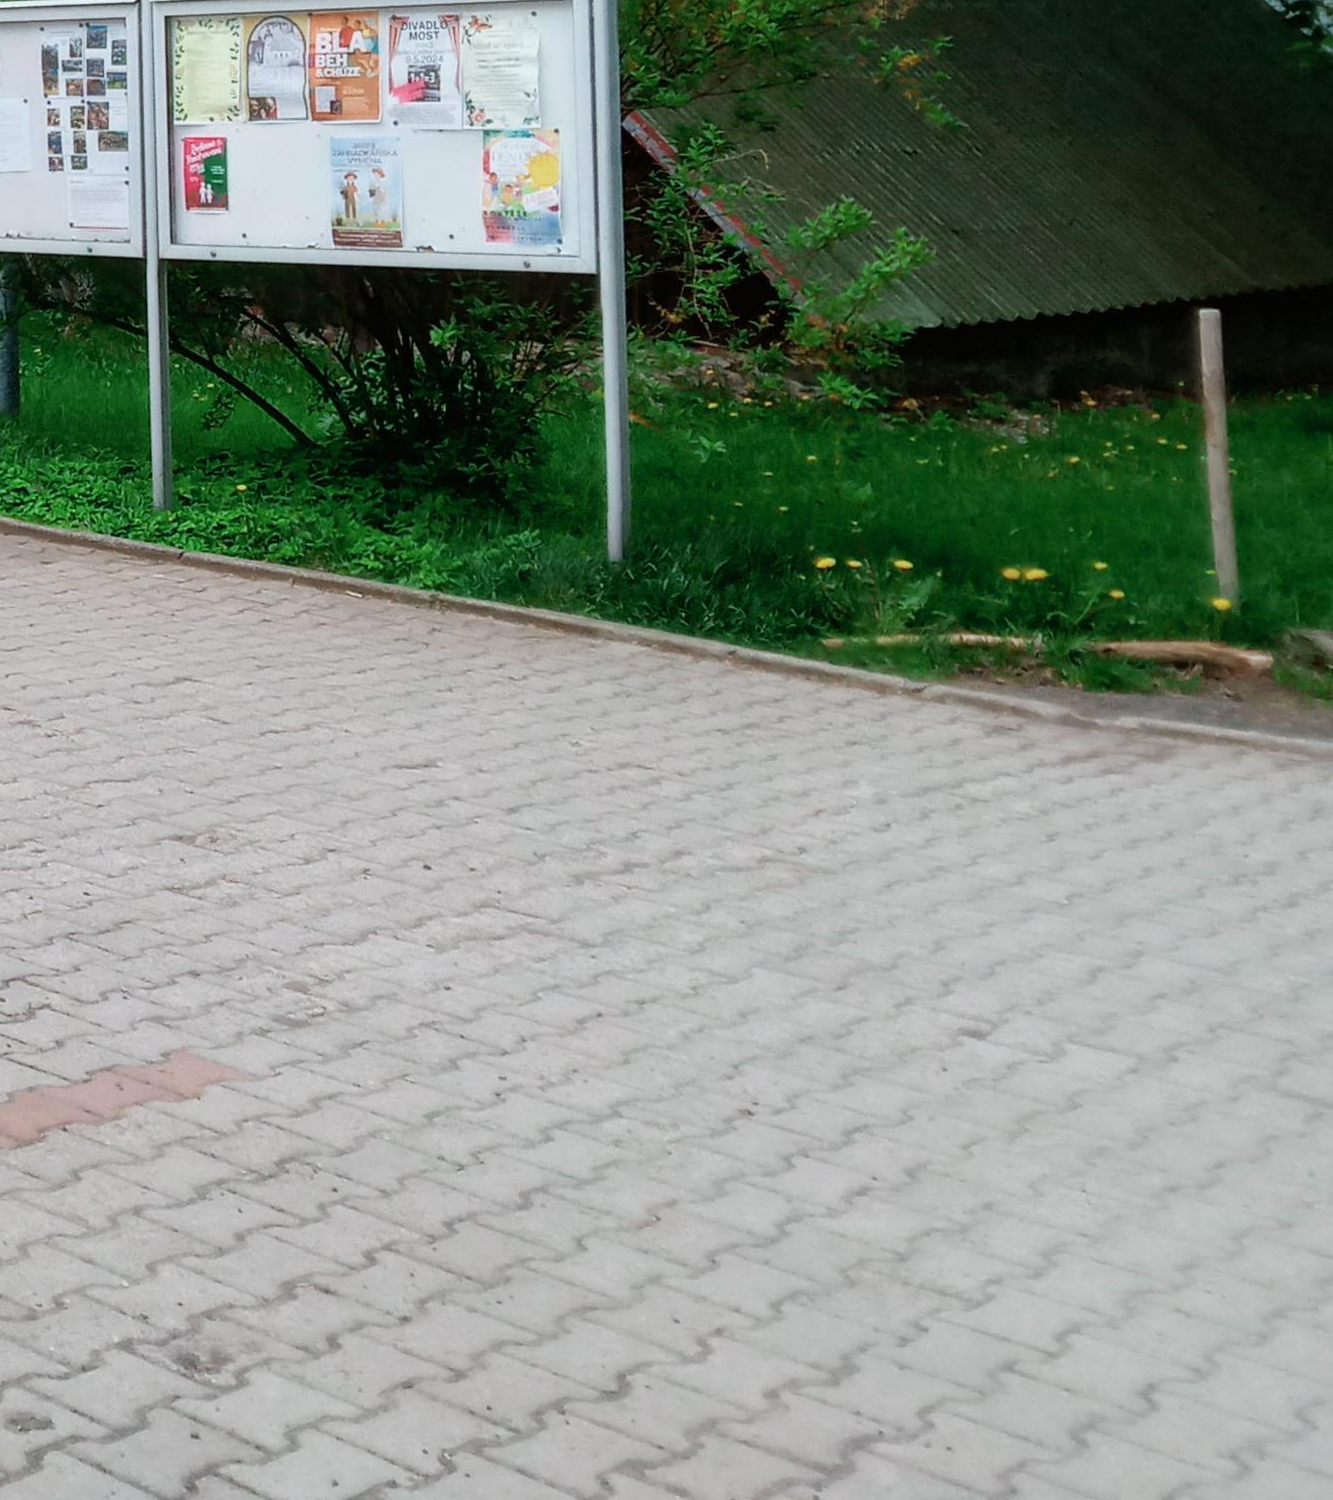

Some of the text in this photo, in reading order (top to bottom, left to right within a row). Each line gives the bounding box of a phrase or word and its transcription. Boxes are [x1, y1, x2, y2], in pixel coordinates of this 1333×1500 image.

[401, 20, 448, 31] DIVADLO
[315, 30, 367, 53] BLA
[409, 31, 439, 41] MOST
